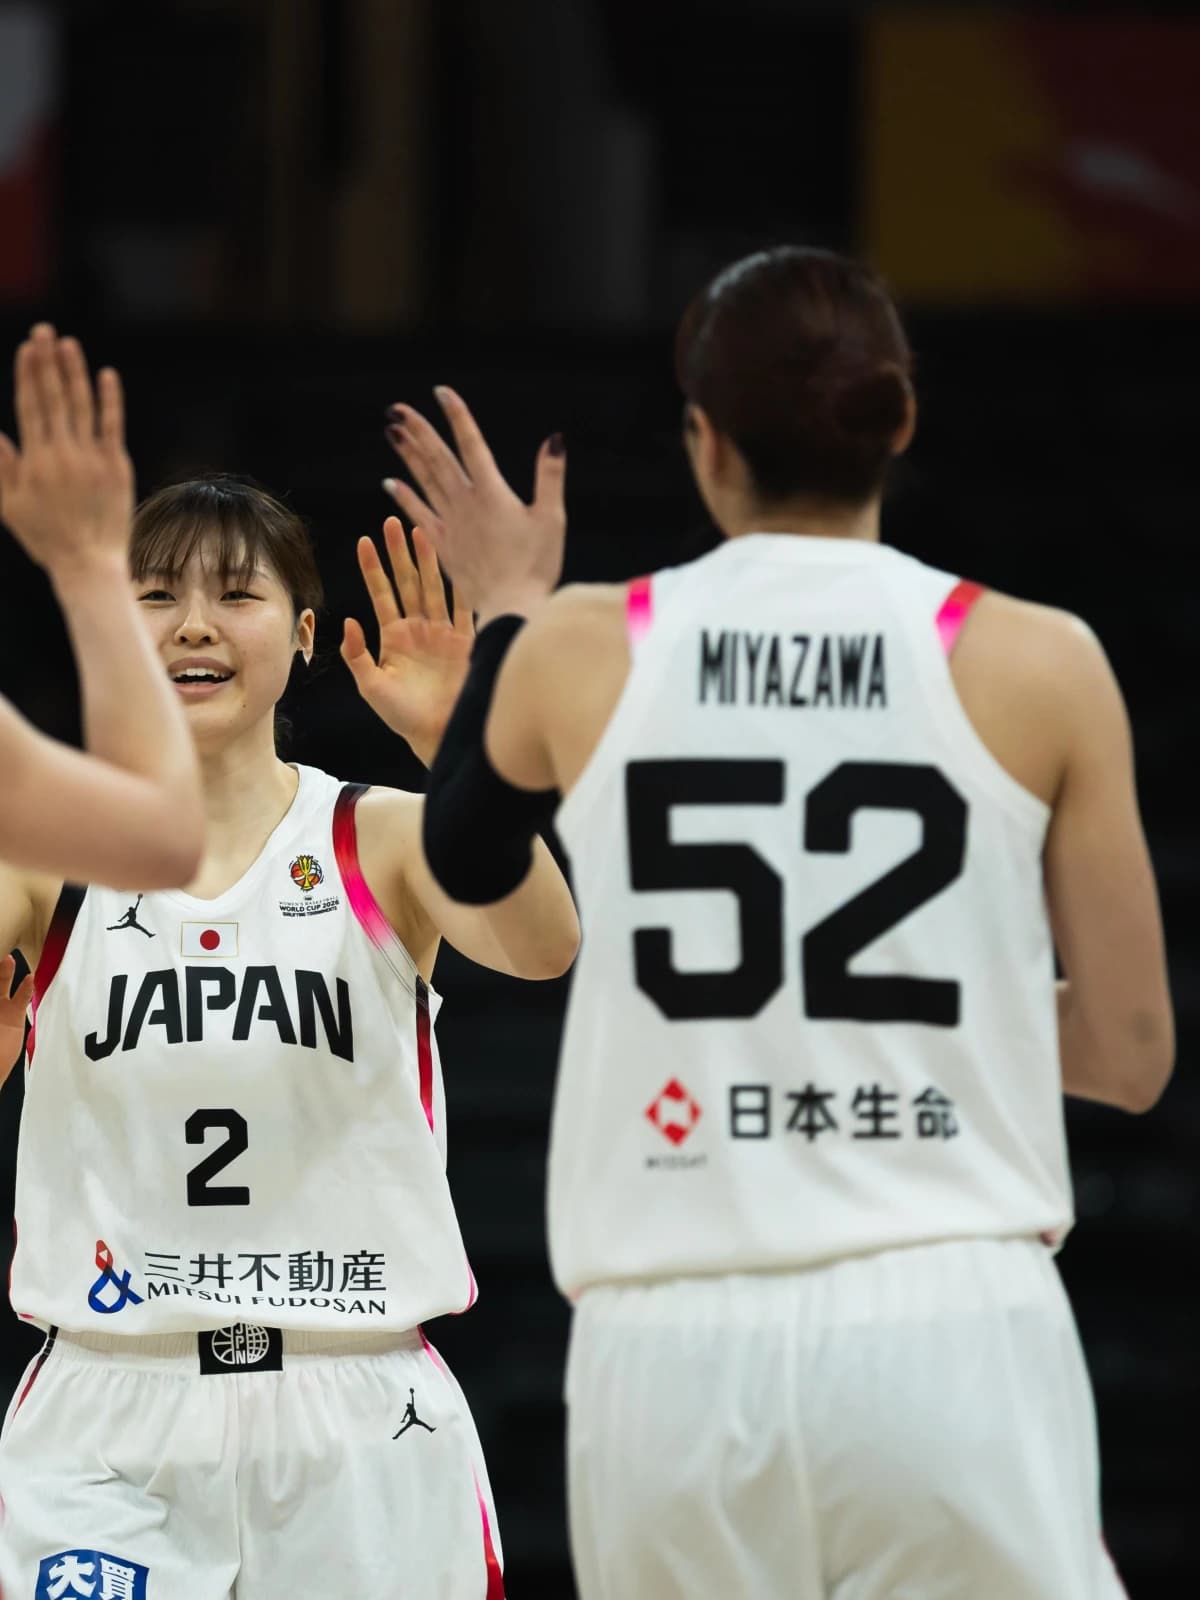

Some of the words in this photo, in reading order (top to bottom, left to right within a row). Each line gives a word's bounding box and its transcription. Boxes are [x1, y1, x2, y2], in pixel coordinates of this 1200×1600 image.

[700, 629, 887, 708] MIYAZAWA
[322, 900, 340, 908] 2026
[626, 757, 969, 1029] 52
[85, 965, 354, 1063] JAPAN
[728, 1083, 960, 1144] 日本生命
[185, 1108, 250, 1206] 2
[144, 1250, 387, 1293] 三井不動産
[148, 1281, 241, 1305] MITSUI
[252, 1296, 386, 1315] FUDOSAN
